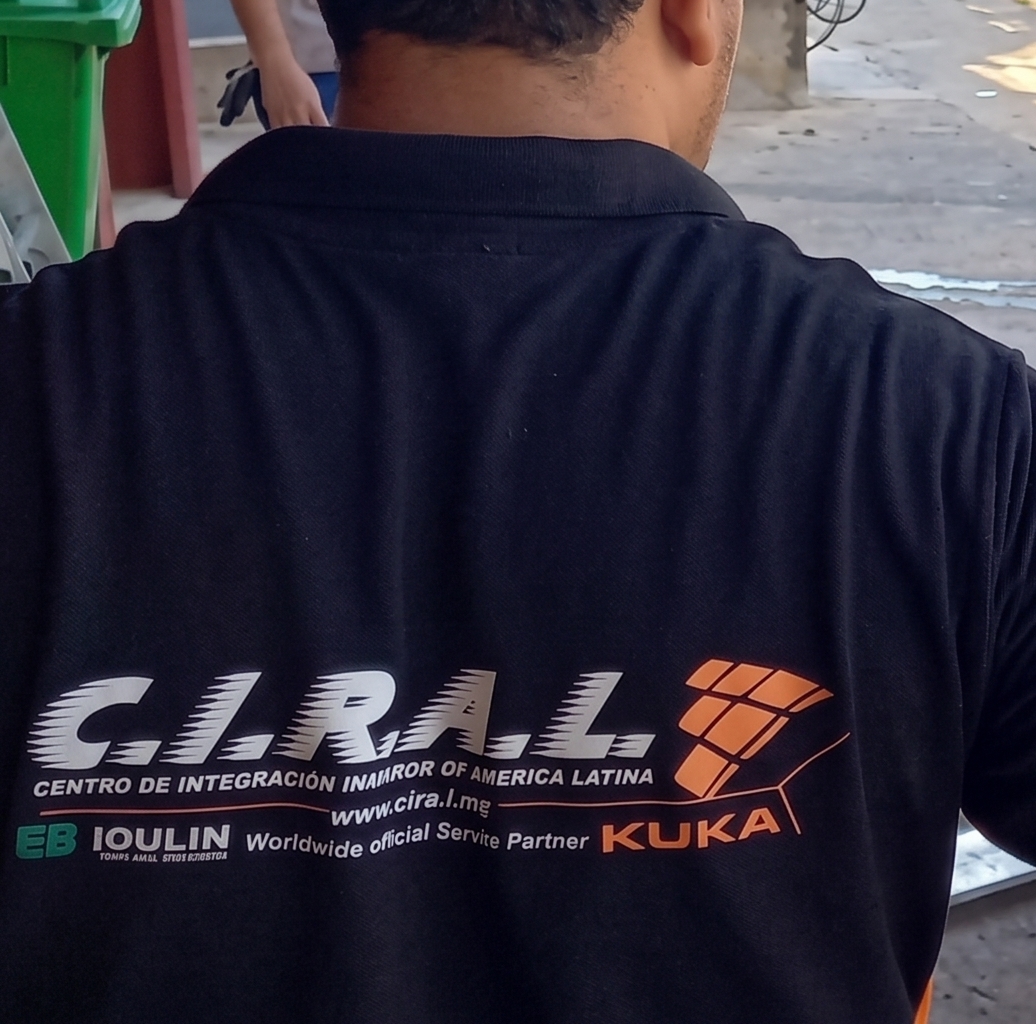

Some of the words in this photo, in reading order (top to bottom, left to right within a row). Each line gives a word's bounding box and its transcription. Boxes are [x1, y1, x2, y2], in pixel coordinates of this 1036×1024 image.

[33, 776, 132, 797] CENTRO
[138, 777, 171, 794] DE
[177, 770, 336, 794] INTEGRACIÓN
[441, 760, 468, 778] OF
[470, 766, 565, 787] AMERICA
[571, 768, 654, 787] LATINA
[246, 832, 364, 859] Worldwide
[506, 832, 590, 851] Partner
[602, 807, 781, 853] KUKA
